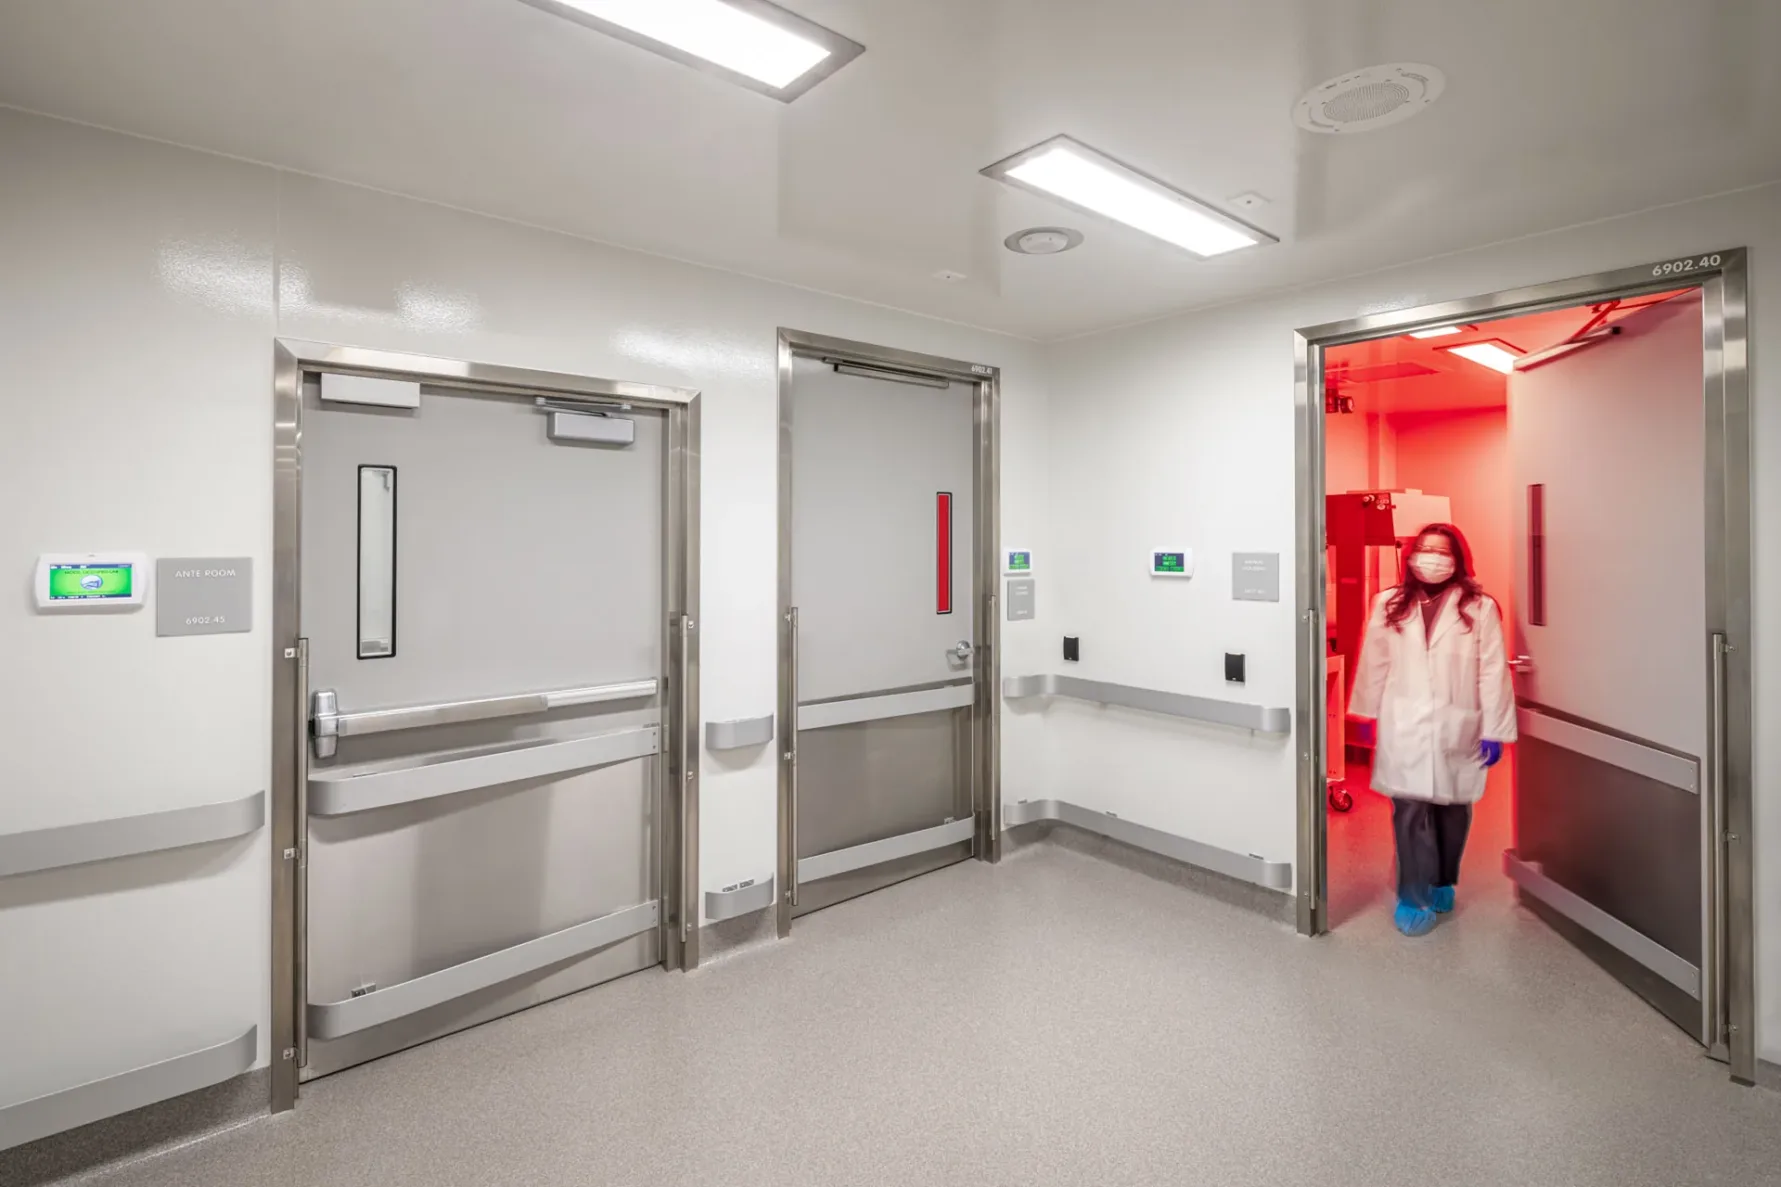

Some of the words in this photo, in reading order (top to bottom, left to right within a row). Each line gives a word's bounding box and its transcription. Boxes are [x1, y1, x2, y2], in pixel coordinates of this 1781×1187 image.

[1652, 254, 1721, 276] 6902.40
[174, 569, 201, 578] ANTE
[204, 568, 236, 578] ROOM
[185, 615, 226, 625] 6902.45
